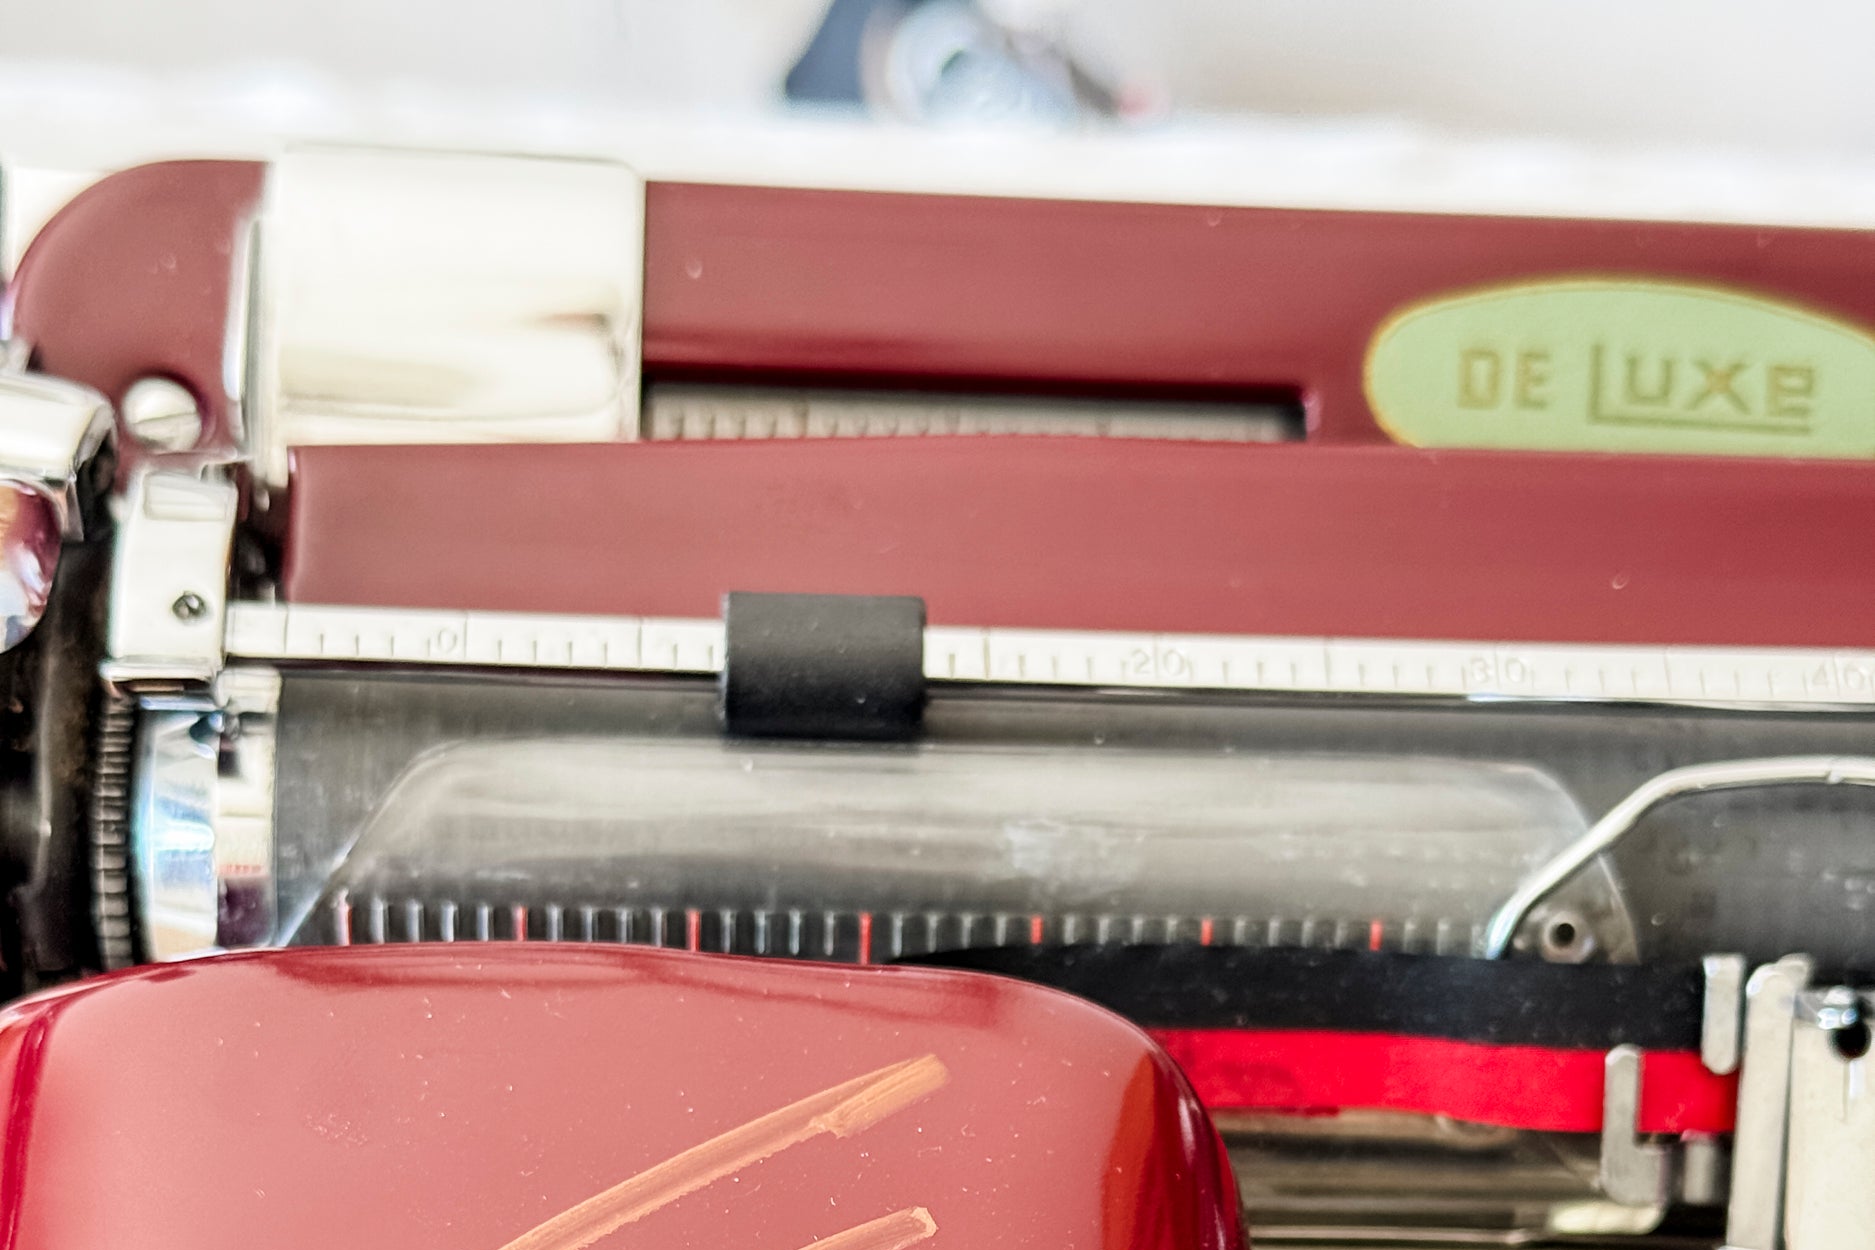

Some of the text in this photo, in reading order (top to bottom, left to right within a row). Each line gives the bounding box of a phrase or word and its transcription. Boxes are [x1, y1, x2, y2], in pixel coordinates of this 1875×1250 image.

[1458, 347, 1549, 410] DE
[1130, 647, 1187, 677] 20
[1469, 656, 1527, 685] 30
